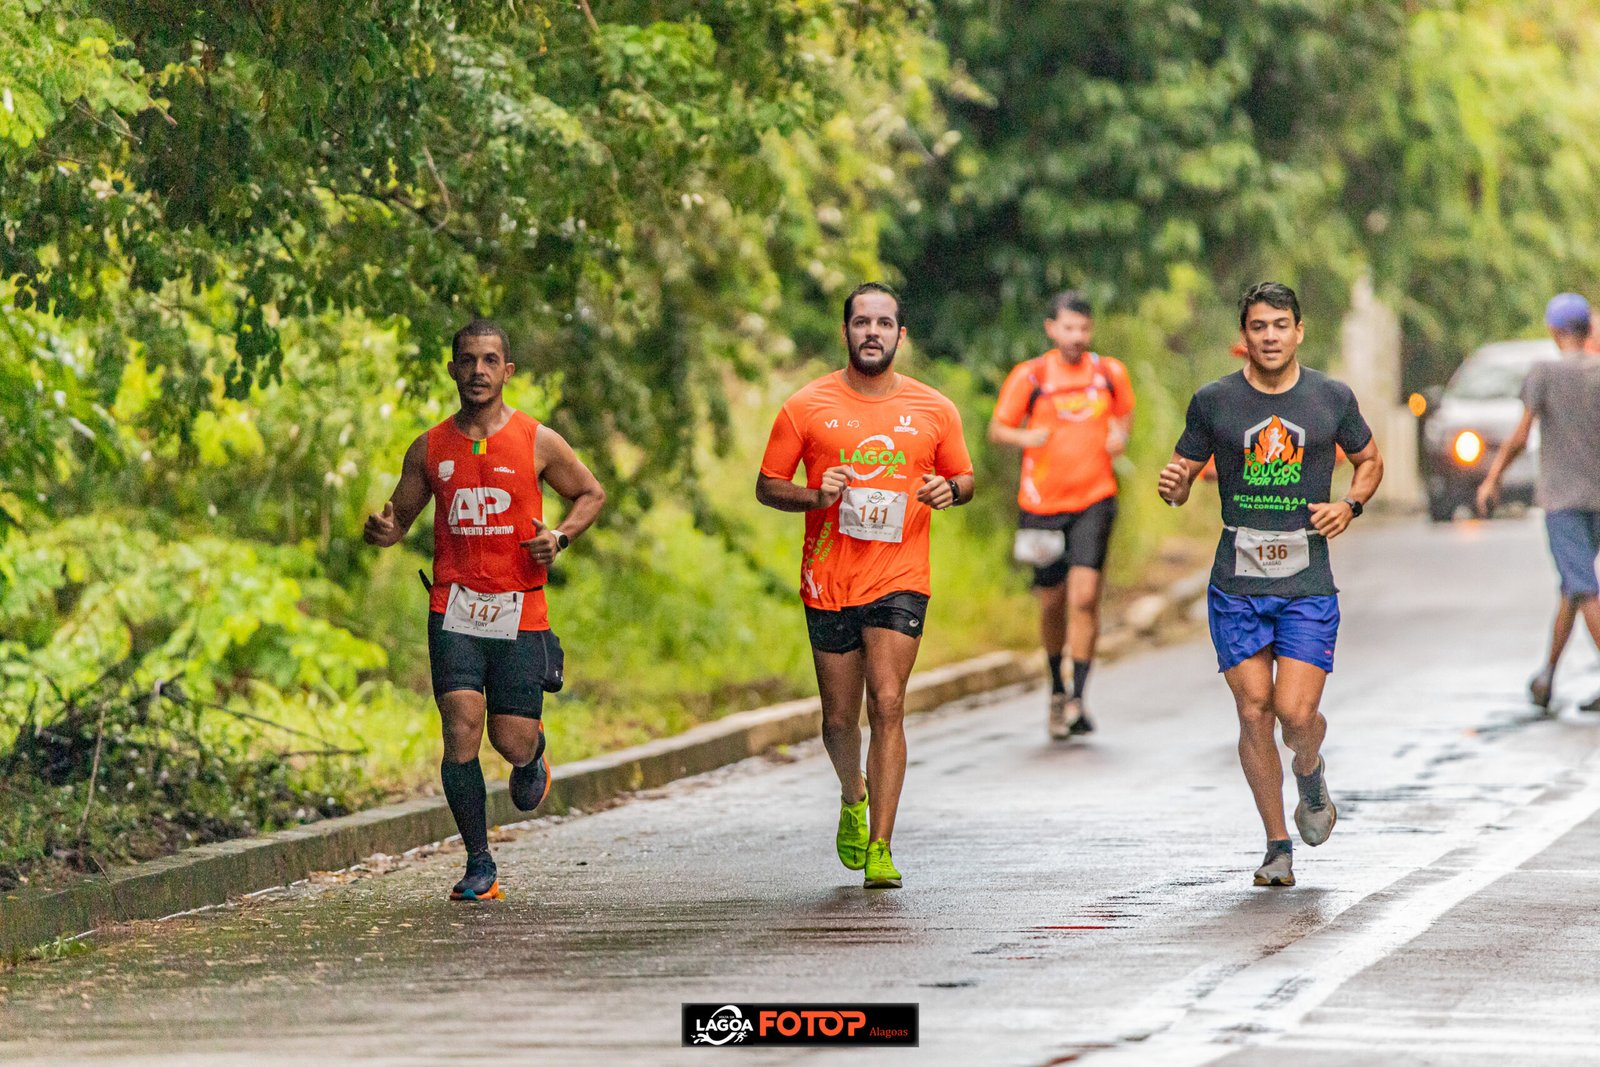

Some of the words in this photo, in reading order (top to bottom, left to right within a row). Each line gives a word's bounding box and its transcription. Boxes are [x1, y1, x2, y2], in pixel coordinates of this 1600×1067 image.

[839, 448, 907, 465] LAGOA
[1243, 458, 1302, 484] LOUCOS
[1248, 477, 1272, 486] POR
[1273, 477, 1290, 486] KM
[448, 487, 512, 526] AP
[1233, 494, 1307, 505] #CHAMAAAA
[1253, 503, 1285, 511] CORRER
[859, 504, 888, 525] 141
[484, 525, 514, 536] ESPORTIVO
[1255, 544, 1289, 561] 136
[468, 601, 502, 623] 147
